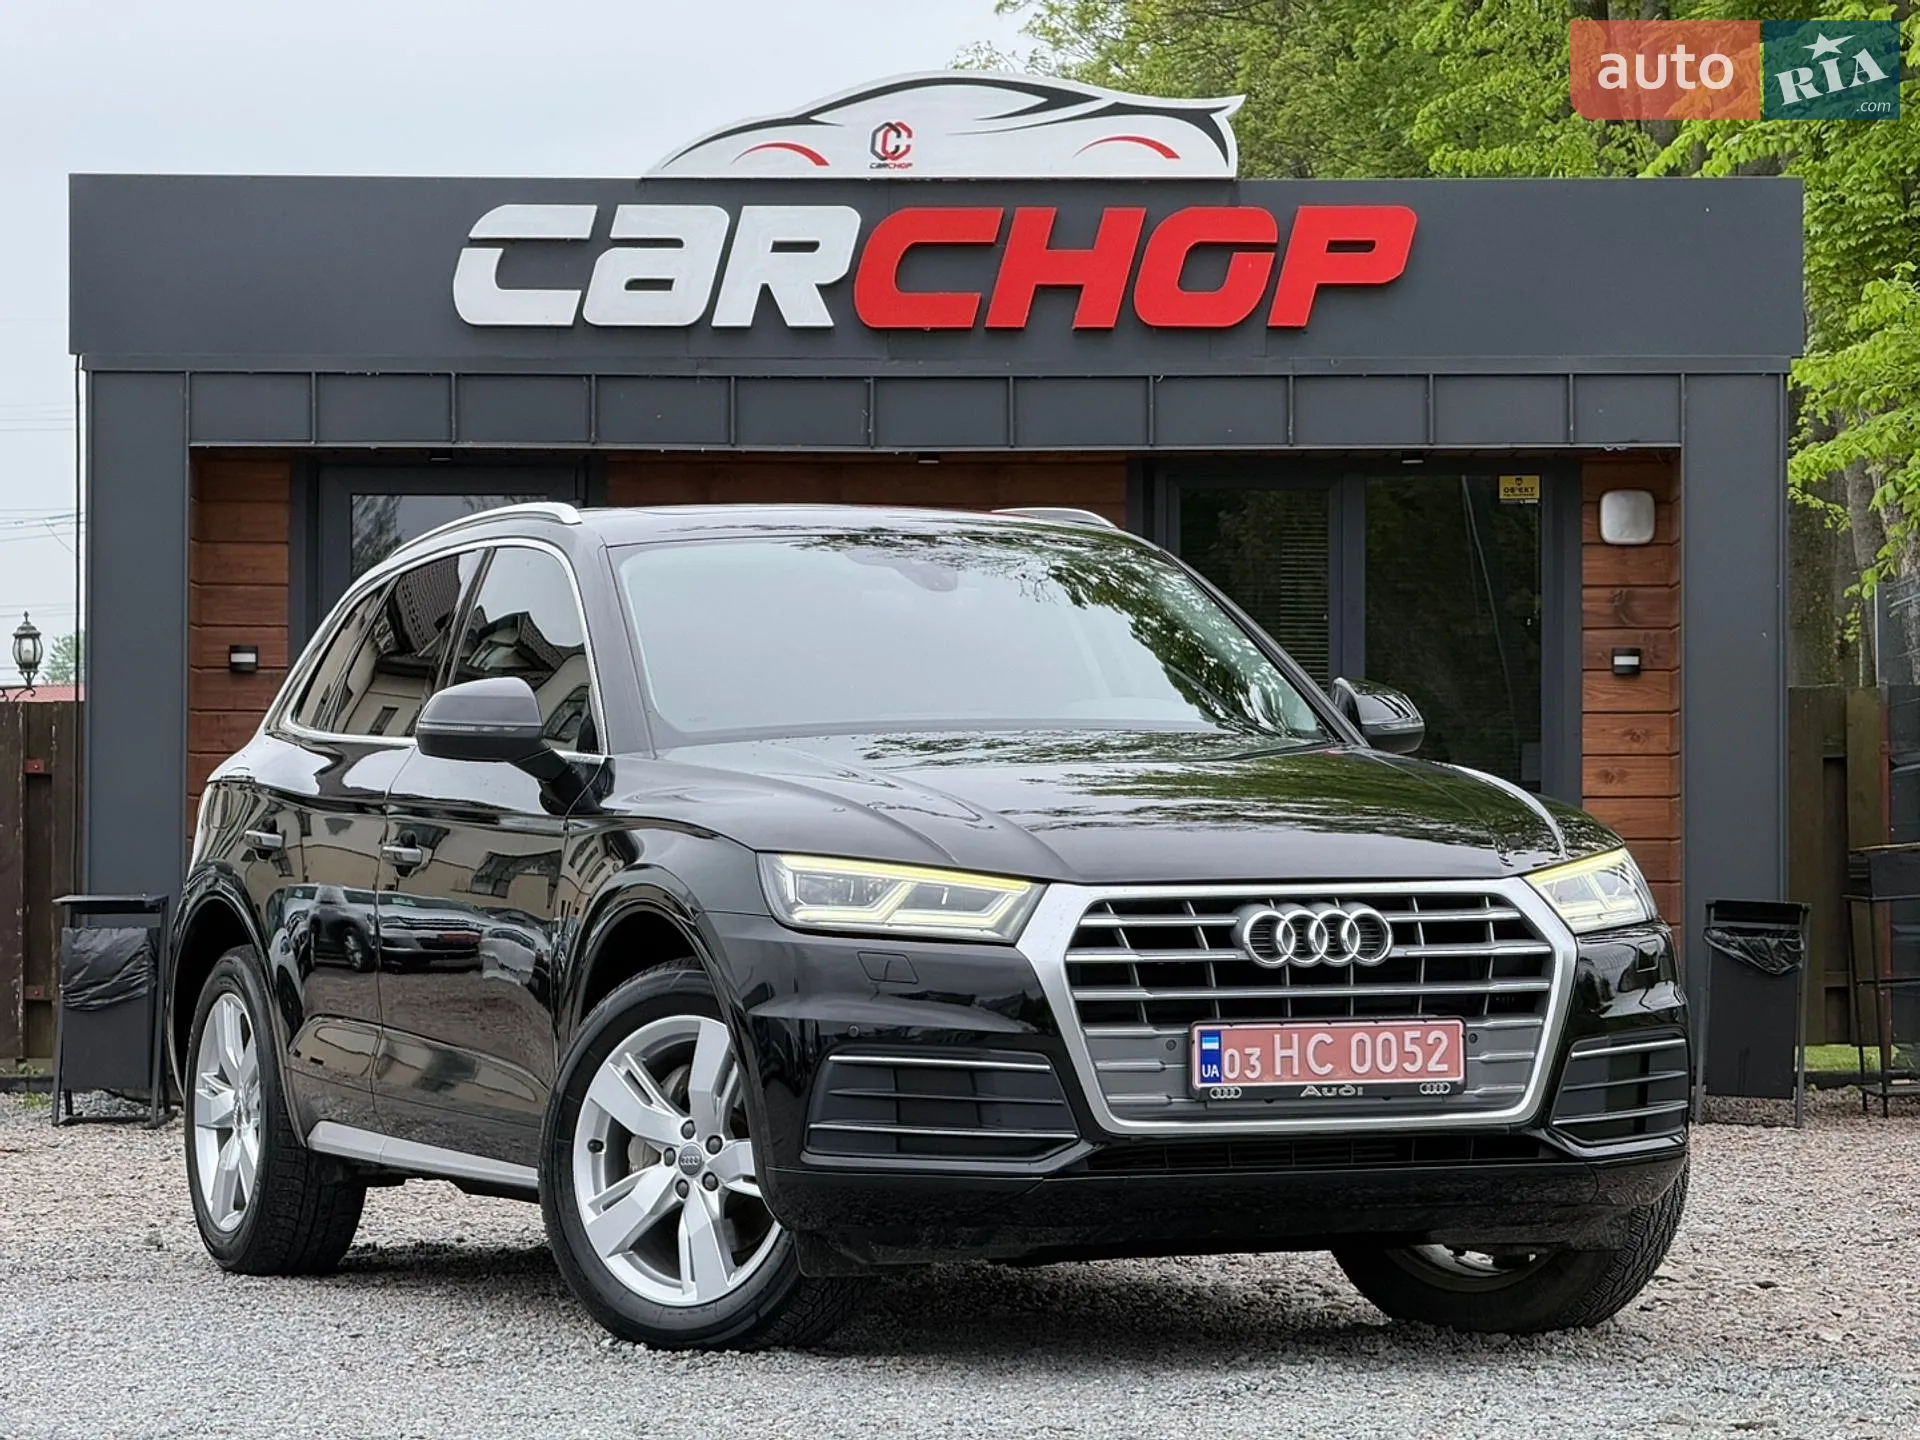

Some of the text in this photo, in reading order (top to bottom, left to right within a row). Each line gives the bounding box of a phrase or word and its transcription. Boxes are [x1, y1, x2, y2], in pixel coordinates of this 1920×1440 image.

[1223, 1030, 1449, 1080] 03 HC 0052
[1201, 1063, 1220, 1079] UA
[1299, 1084, 1364, 1098] Audi
